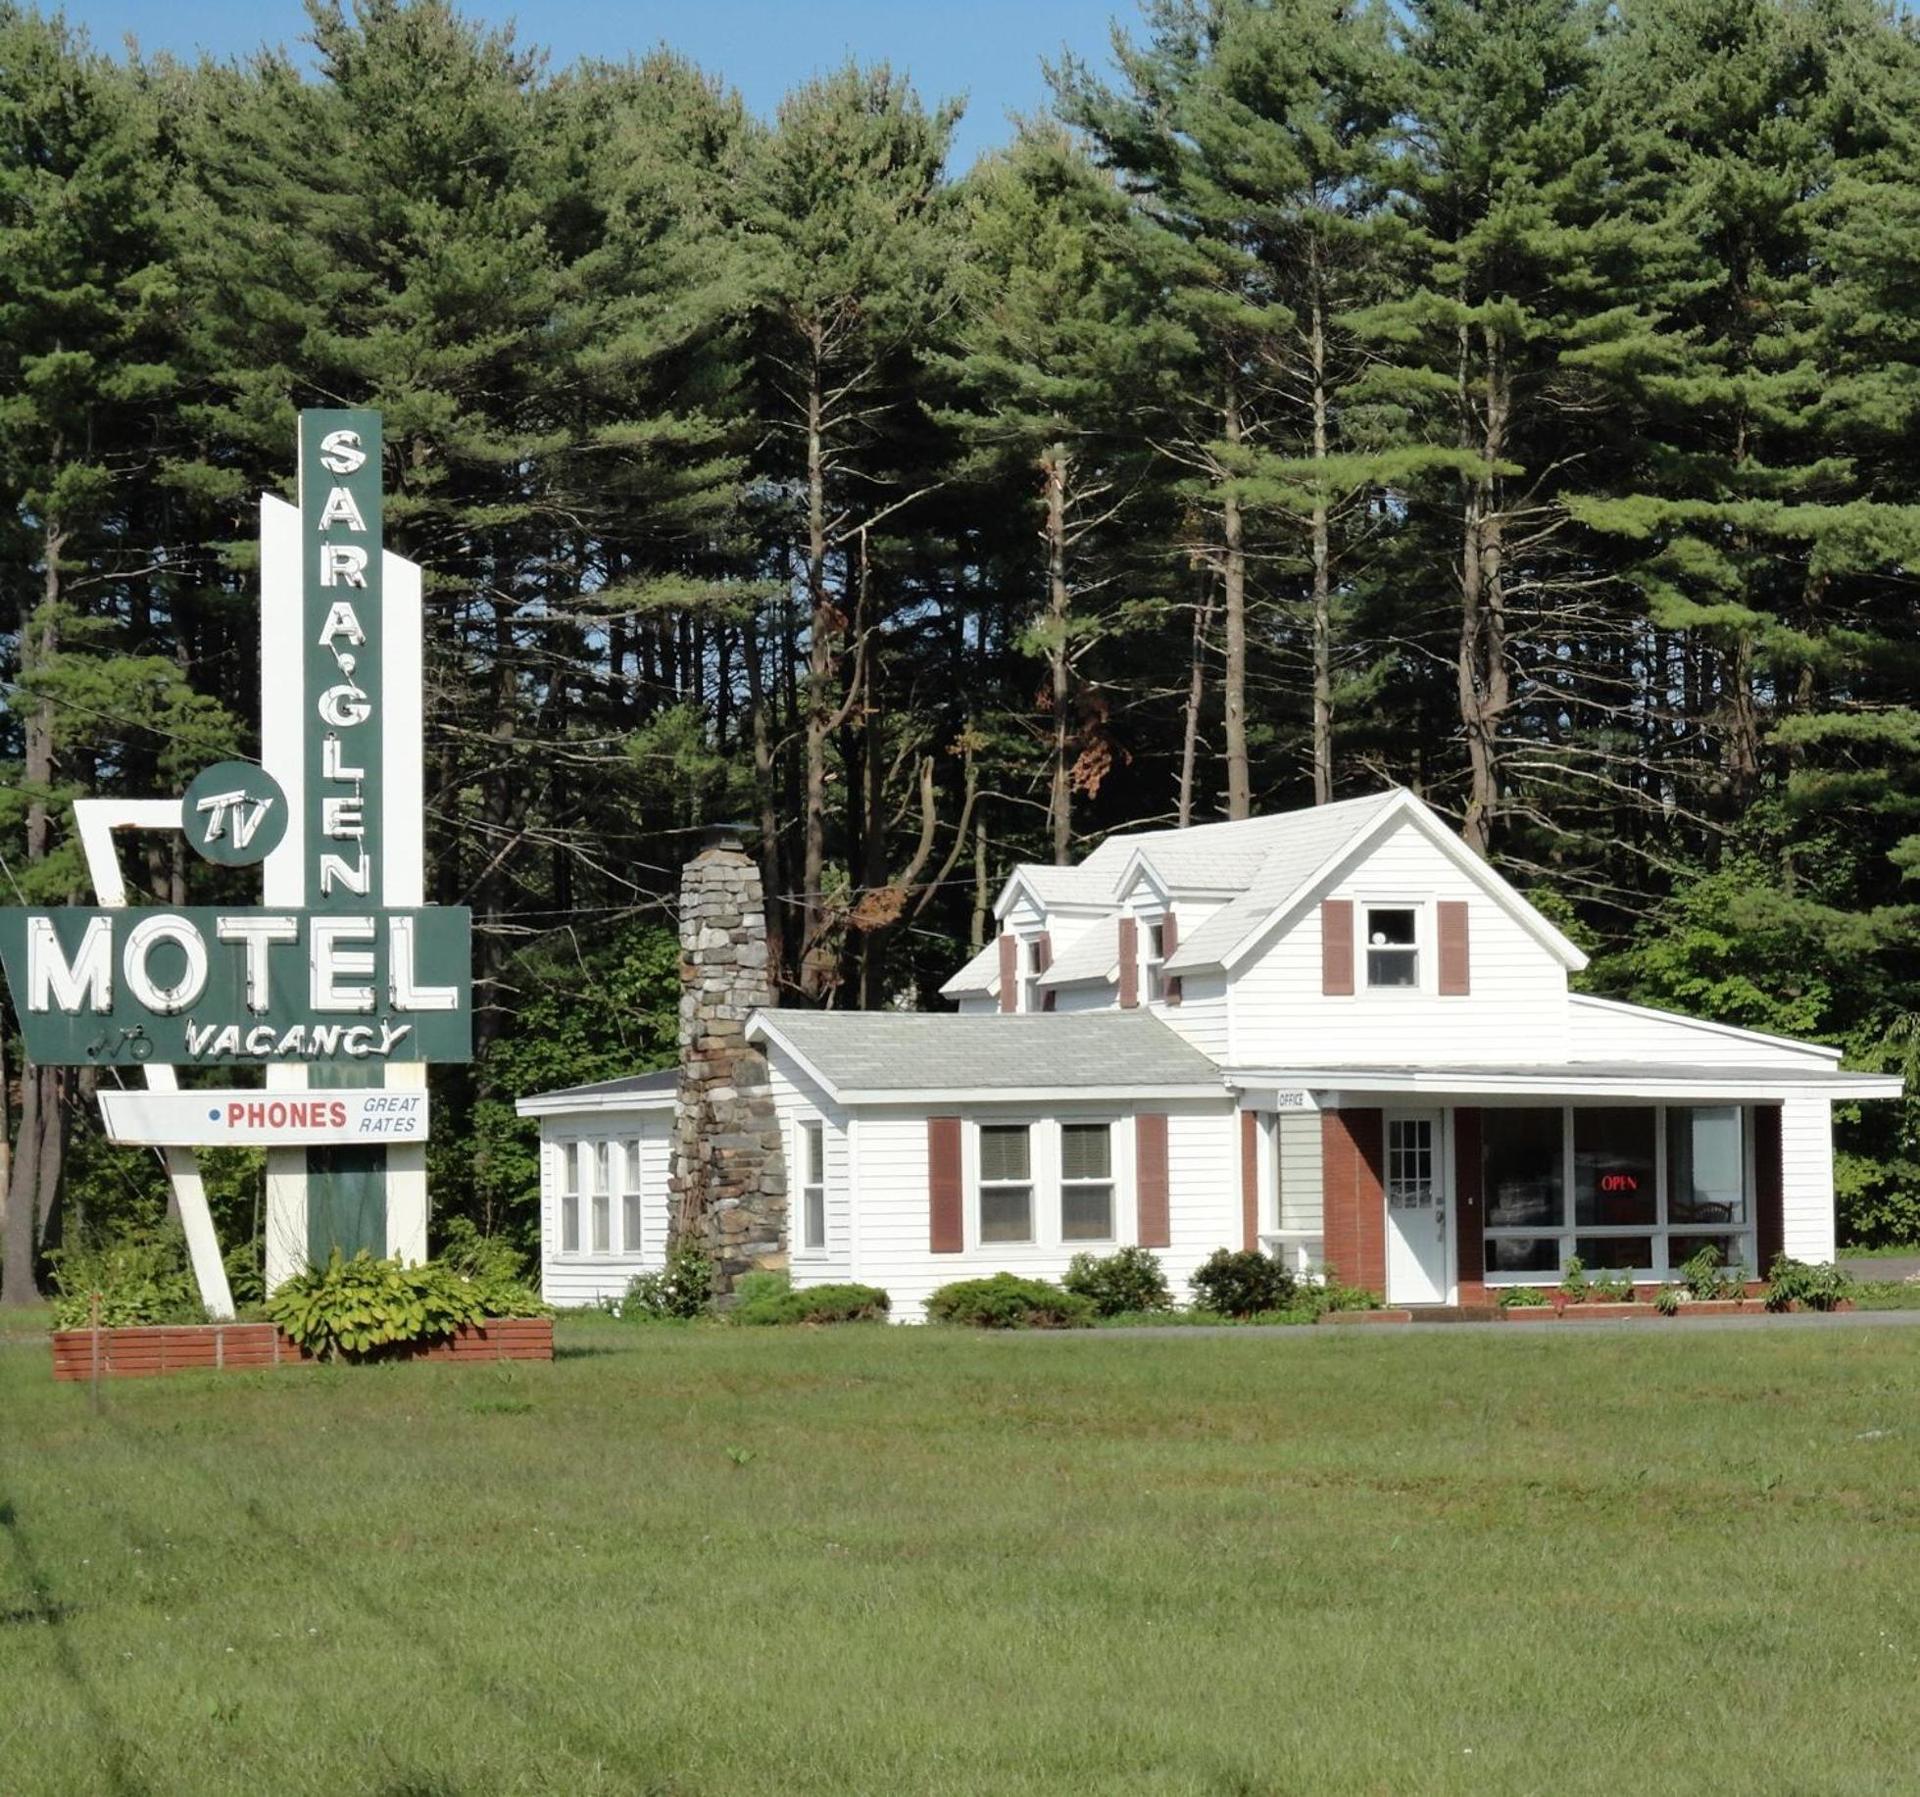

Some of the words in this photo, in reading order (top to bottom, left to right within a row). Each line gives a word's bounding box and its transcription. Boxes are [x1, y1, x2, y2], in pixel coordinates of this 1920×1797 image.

[196, 788, 273, 850] TV
[27, 913, 458, 1014] MOTEL
[187, 1022, 413, 1058] VACANCY
[363, 1097, 421, 1113] GREAT
[1279, 1092, 1303, 1106] OFFICE
[227, 1101, 347, 1129] PHONES
[359, 1117, 417, 1133] RATES
[1601, 1174, 1638, 1191] OPEN
